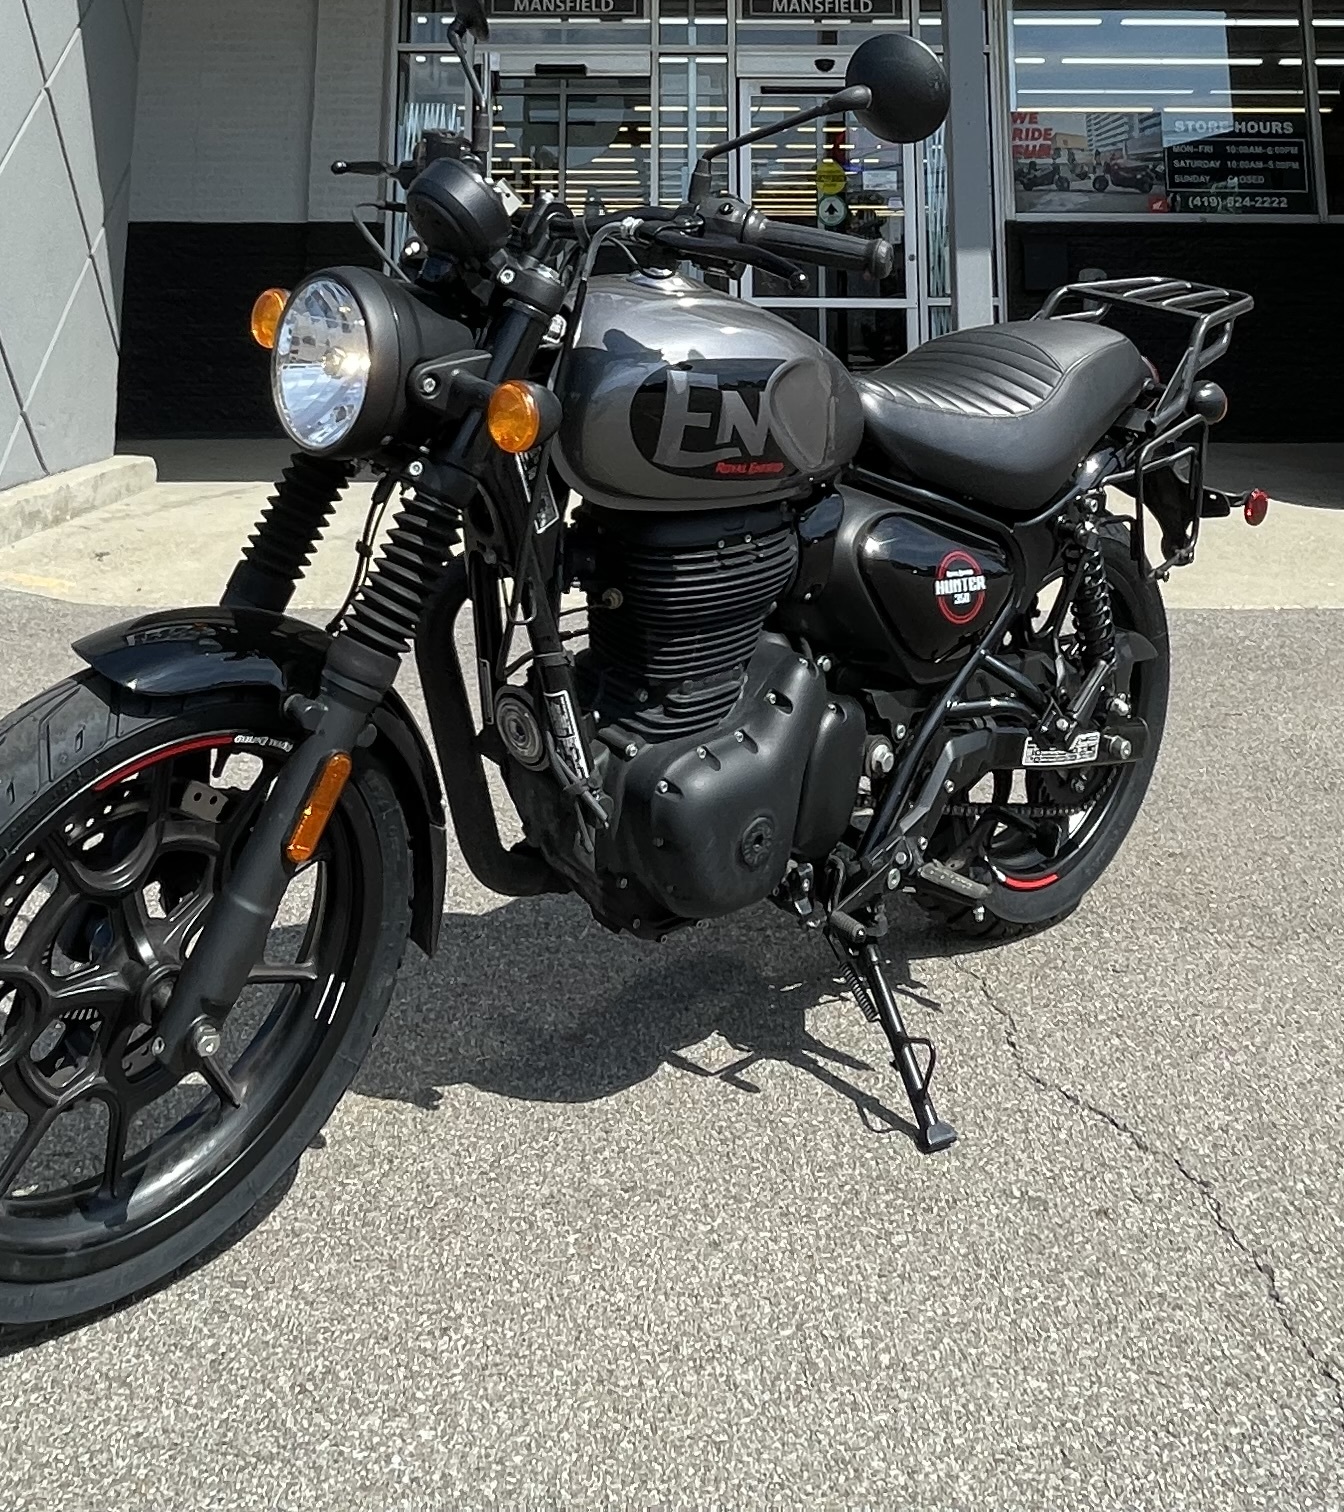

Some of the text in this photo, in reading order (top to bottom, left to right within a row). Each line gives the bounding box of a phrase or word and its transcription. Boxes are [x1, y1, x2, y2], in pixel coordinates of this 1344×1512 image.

[1011, 112, 1039, 124] WE
[1174, 120, 1293, 134] STORE HOURS
[1012, 128, 1053, 141] RIDE
[1173, 159, 1221, 168] SATURDAY
[1227, 175, 1265, 184] COSED
[935, 575, 987, 596] HUNTER
